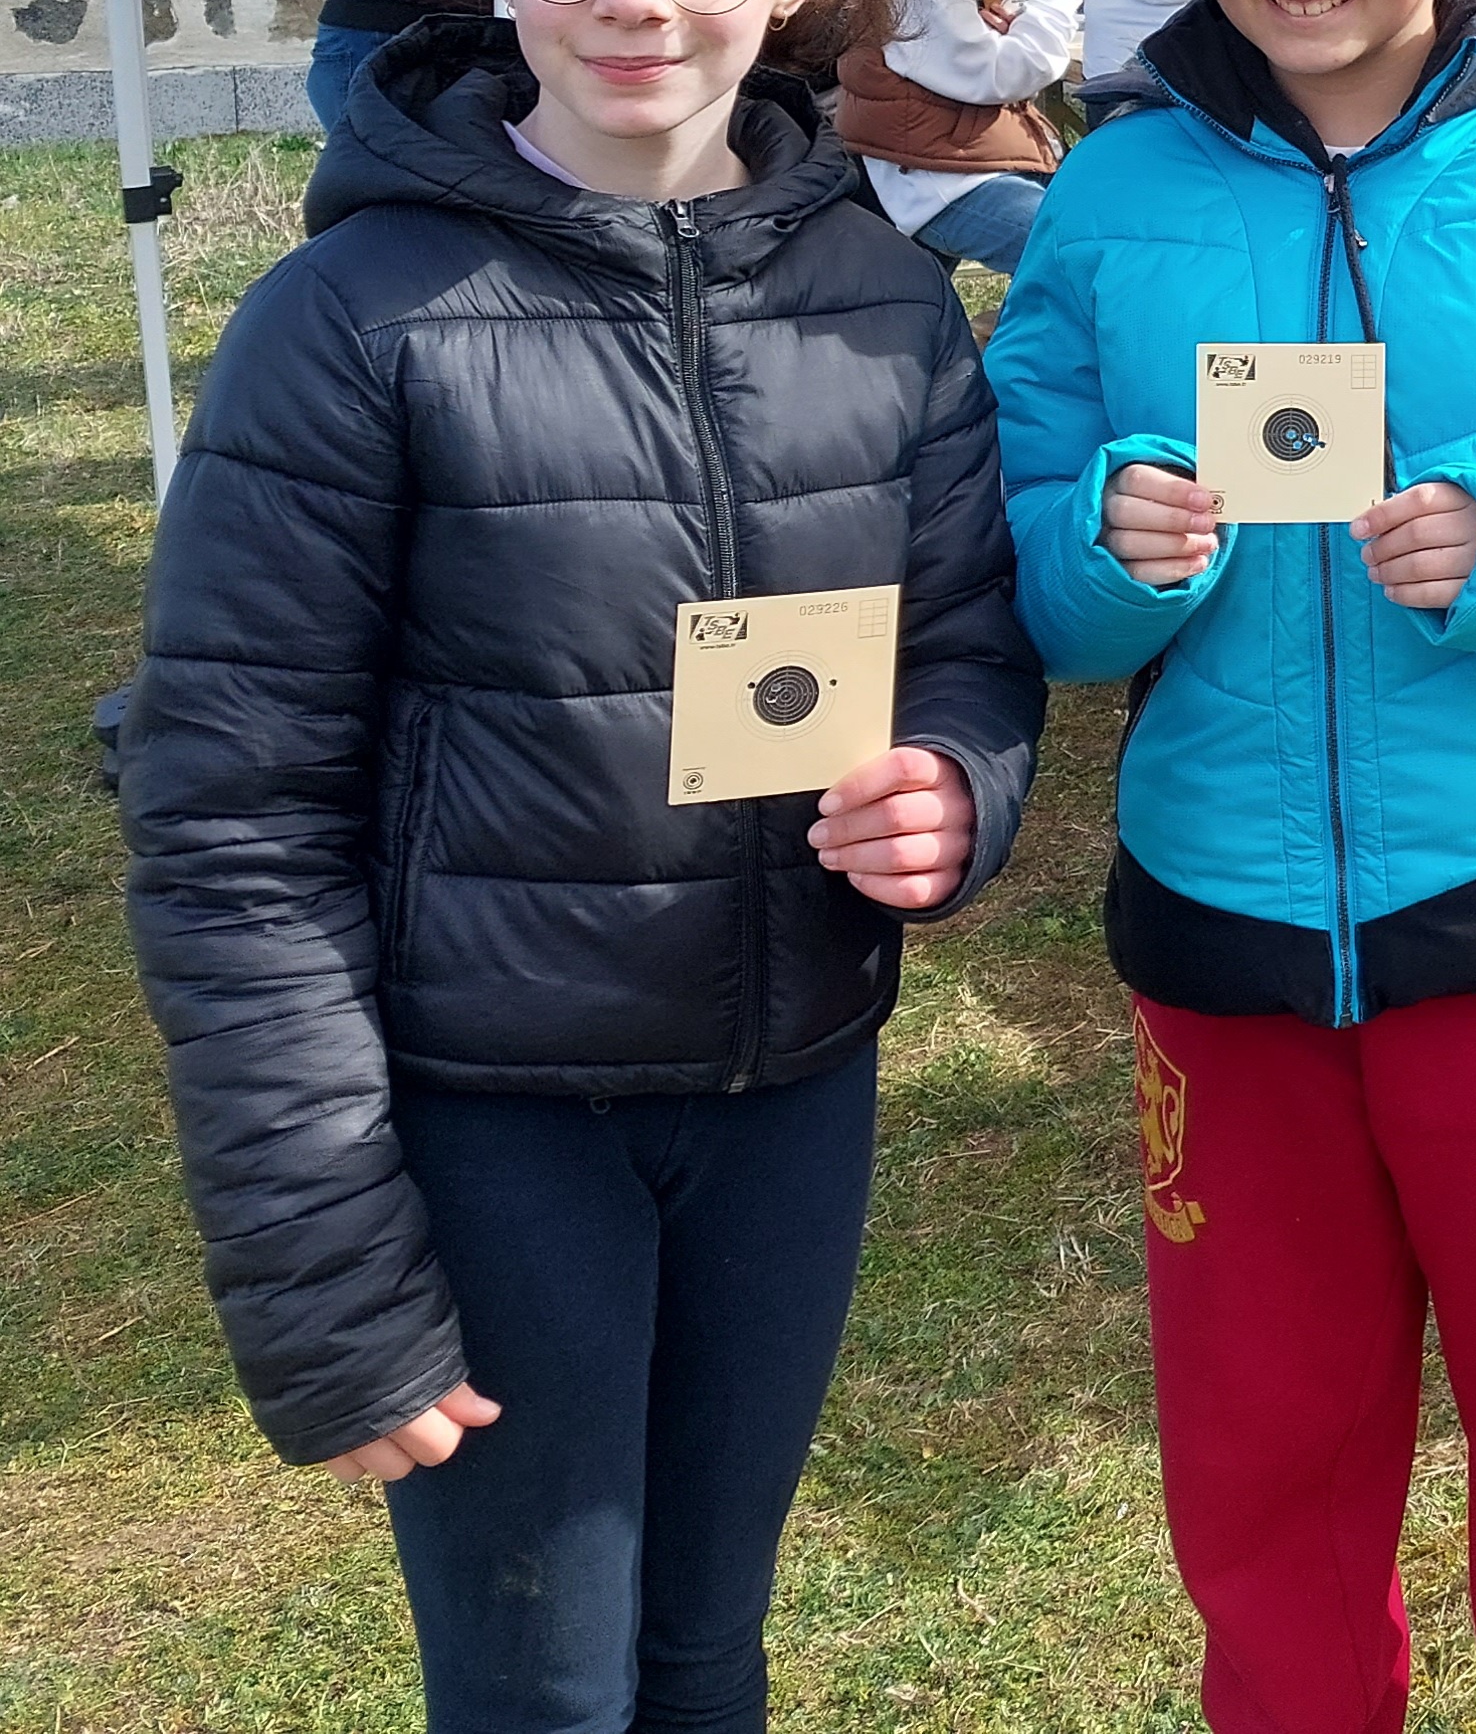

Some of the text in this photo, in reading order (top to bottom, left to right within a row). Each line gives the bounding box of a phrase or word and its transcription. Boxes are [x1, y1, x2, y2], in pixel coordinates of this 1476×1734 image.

[1218, 357, 1246, 378] TSBE
[1299, 354, 1341, 364] 029219
[799, 601, 848, 616] 029226
[703, 616, 736, 639] TSBE
